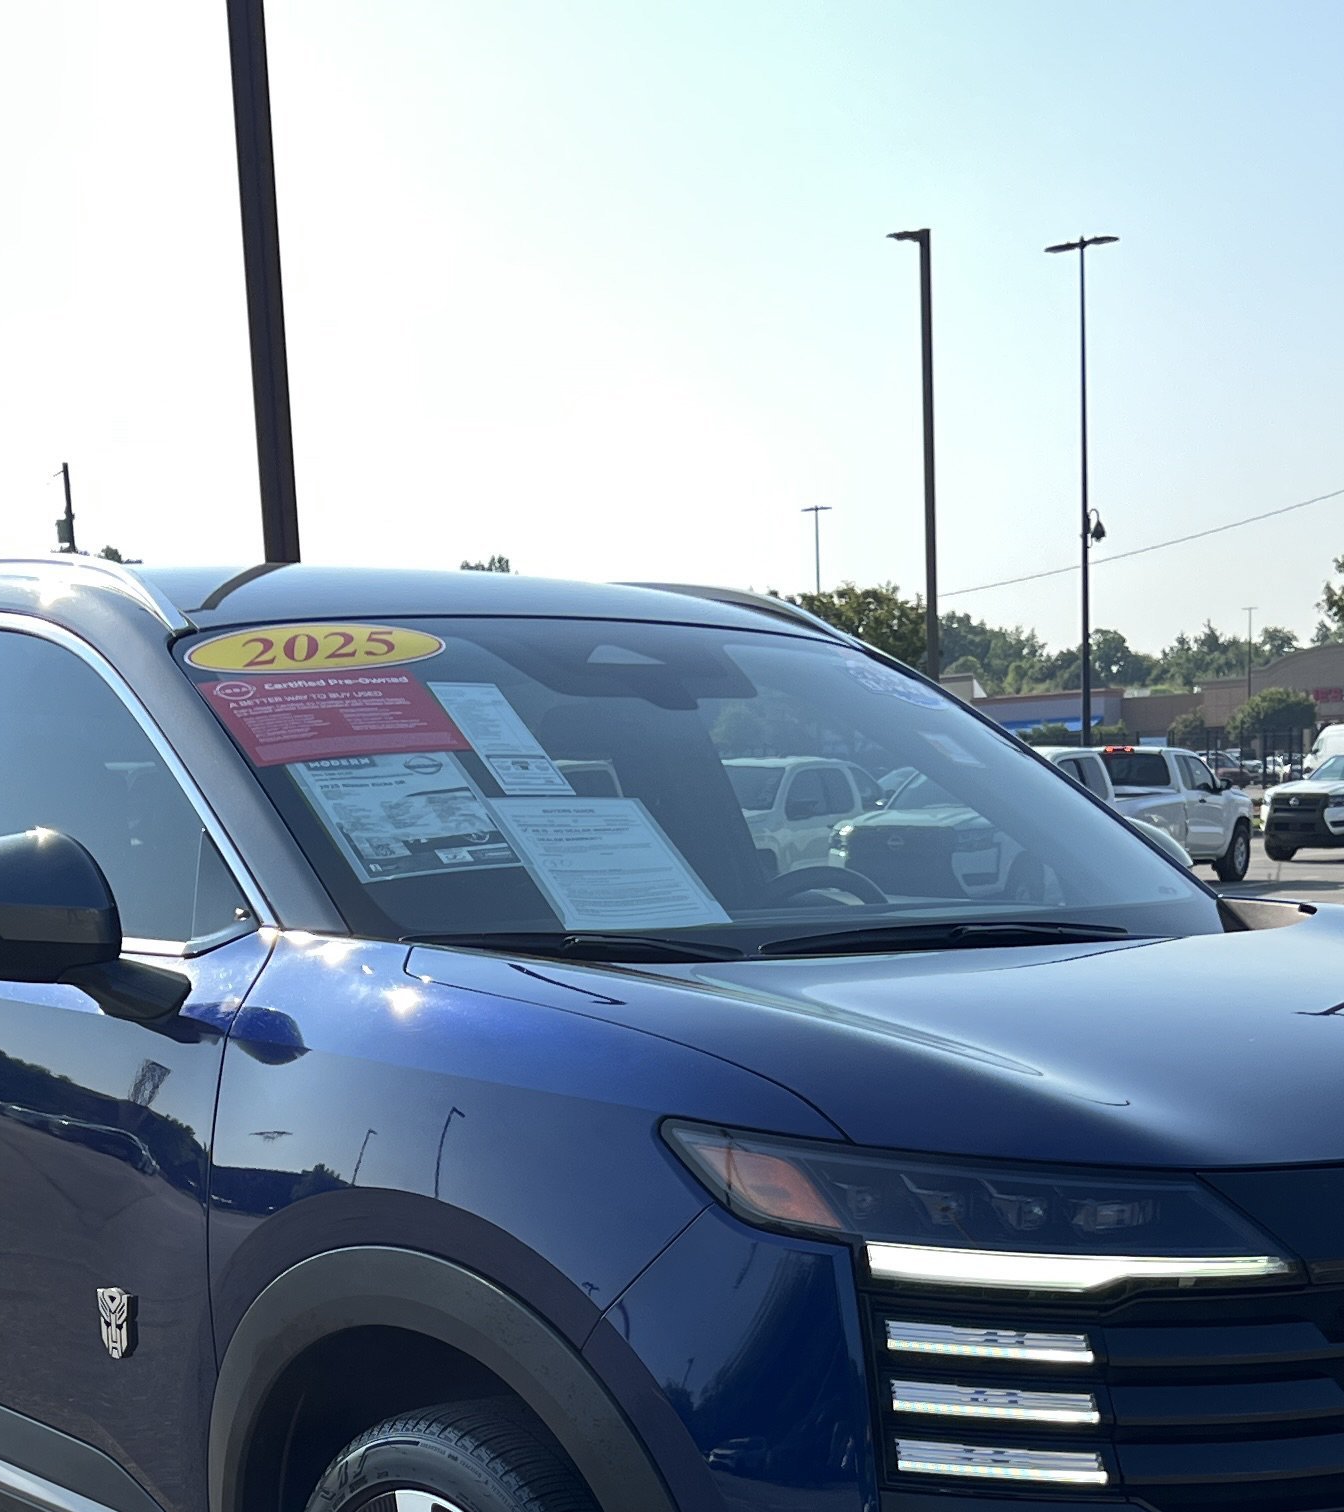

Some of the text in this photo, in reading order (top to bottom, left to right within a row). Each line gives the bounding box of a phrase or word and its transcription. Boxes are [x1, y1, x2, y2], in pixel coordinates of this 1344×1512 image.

[242, 630, 395, 668] 2025
[263, 675, 409, 691] Certified Pre-Owned
